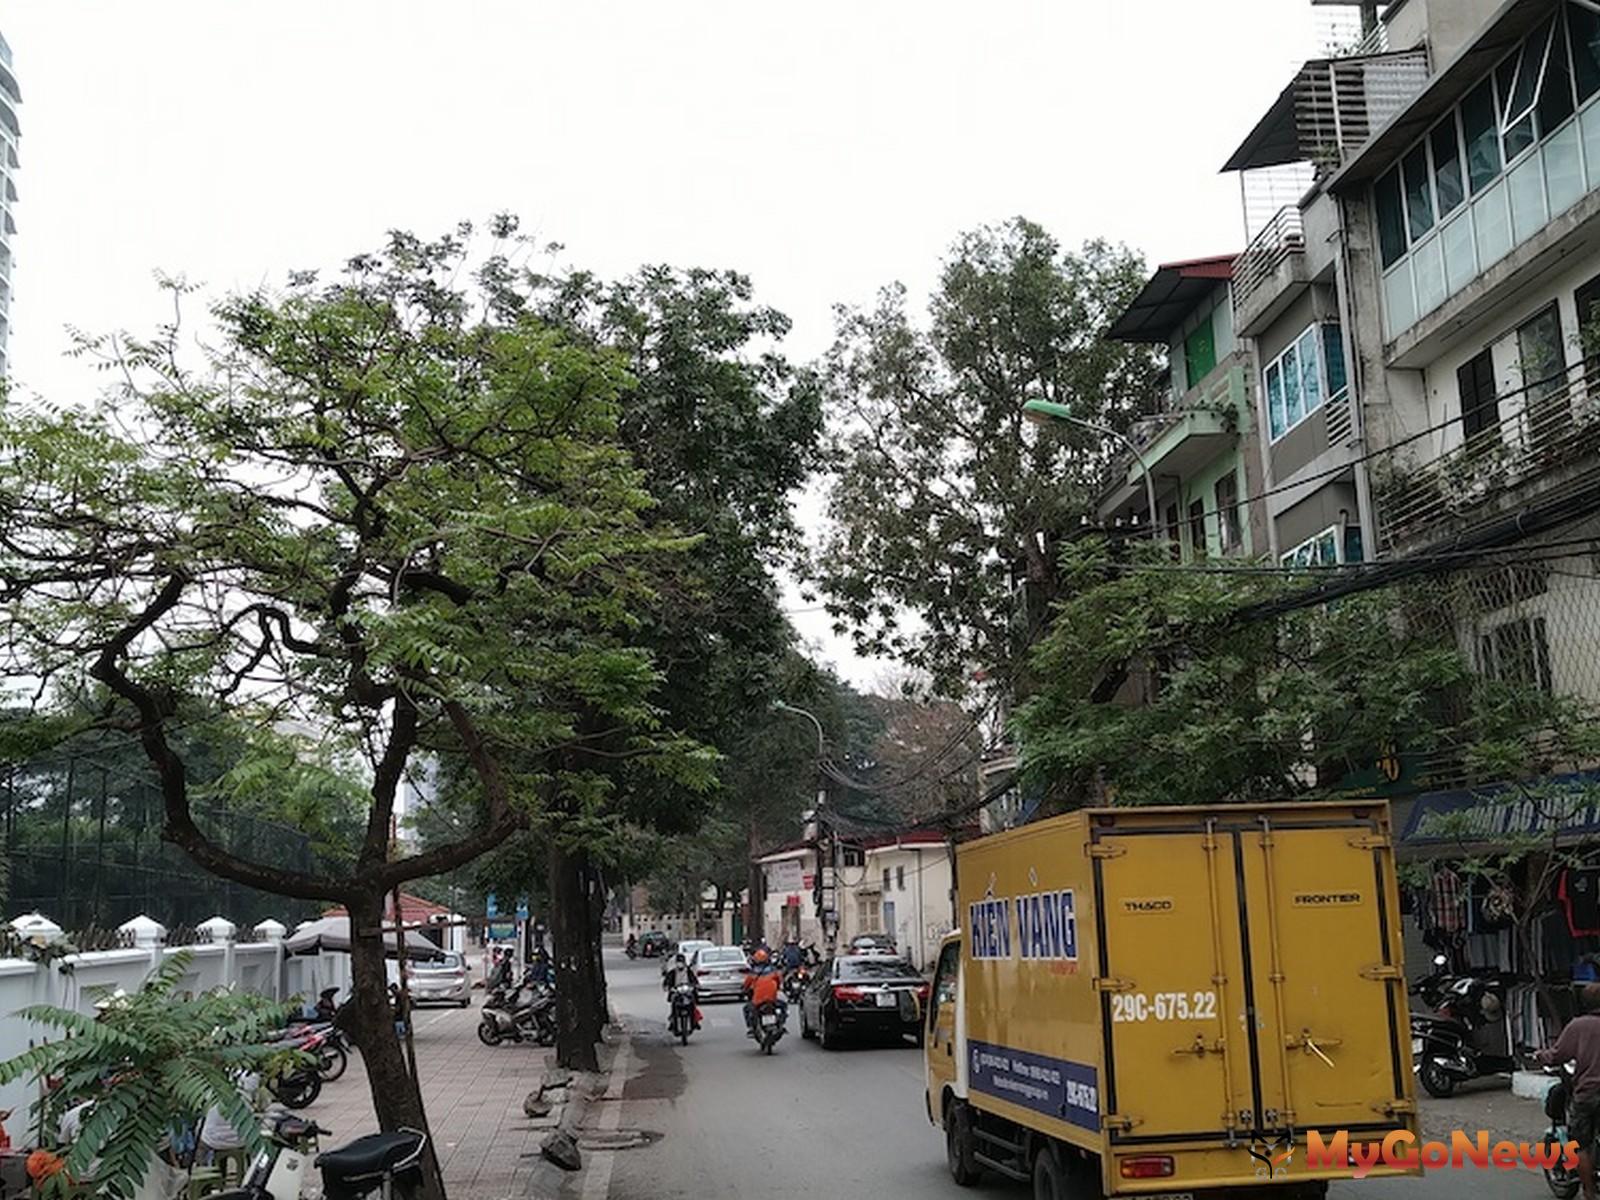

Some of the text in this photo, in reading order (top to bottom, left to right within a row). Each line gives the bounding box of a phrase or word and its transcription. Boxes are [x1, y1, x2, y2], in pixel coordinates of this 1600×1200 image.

[1295, 892, 1361, 904] FRONTIER
[1125, 901, 1172, 911] THACO
[1112, 991, 1217, 1022] 29C-675.22
